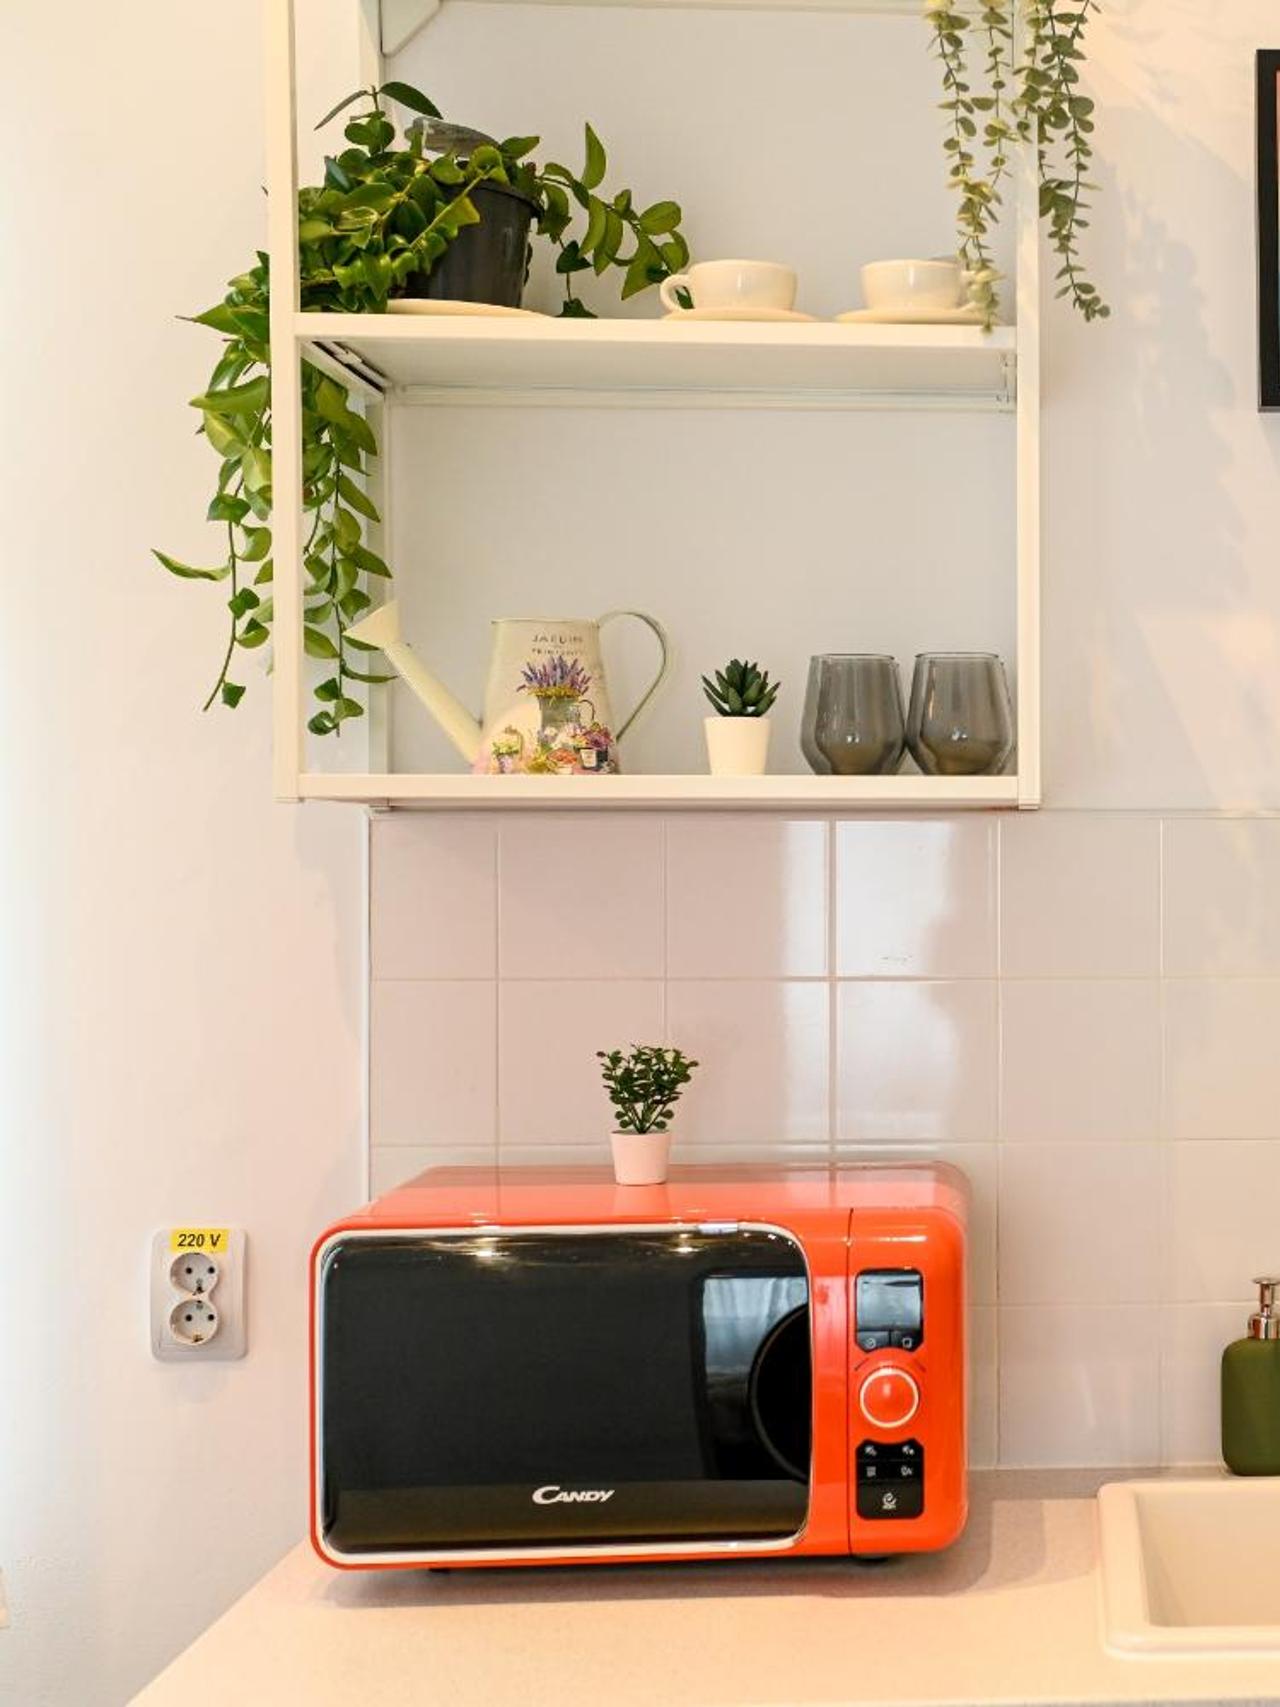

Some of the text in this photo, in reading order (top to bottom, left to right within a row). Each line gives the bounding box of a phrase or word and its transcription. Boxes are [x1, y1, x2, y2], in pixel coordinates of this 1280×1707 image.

[177, 1233, 221, 1248] 220 V
[532, 1485, 615, 1505] CANDY
